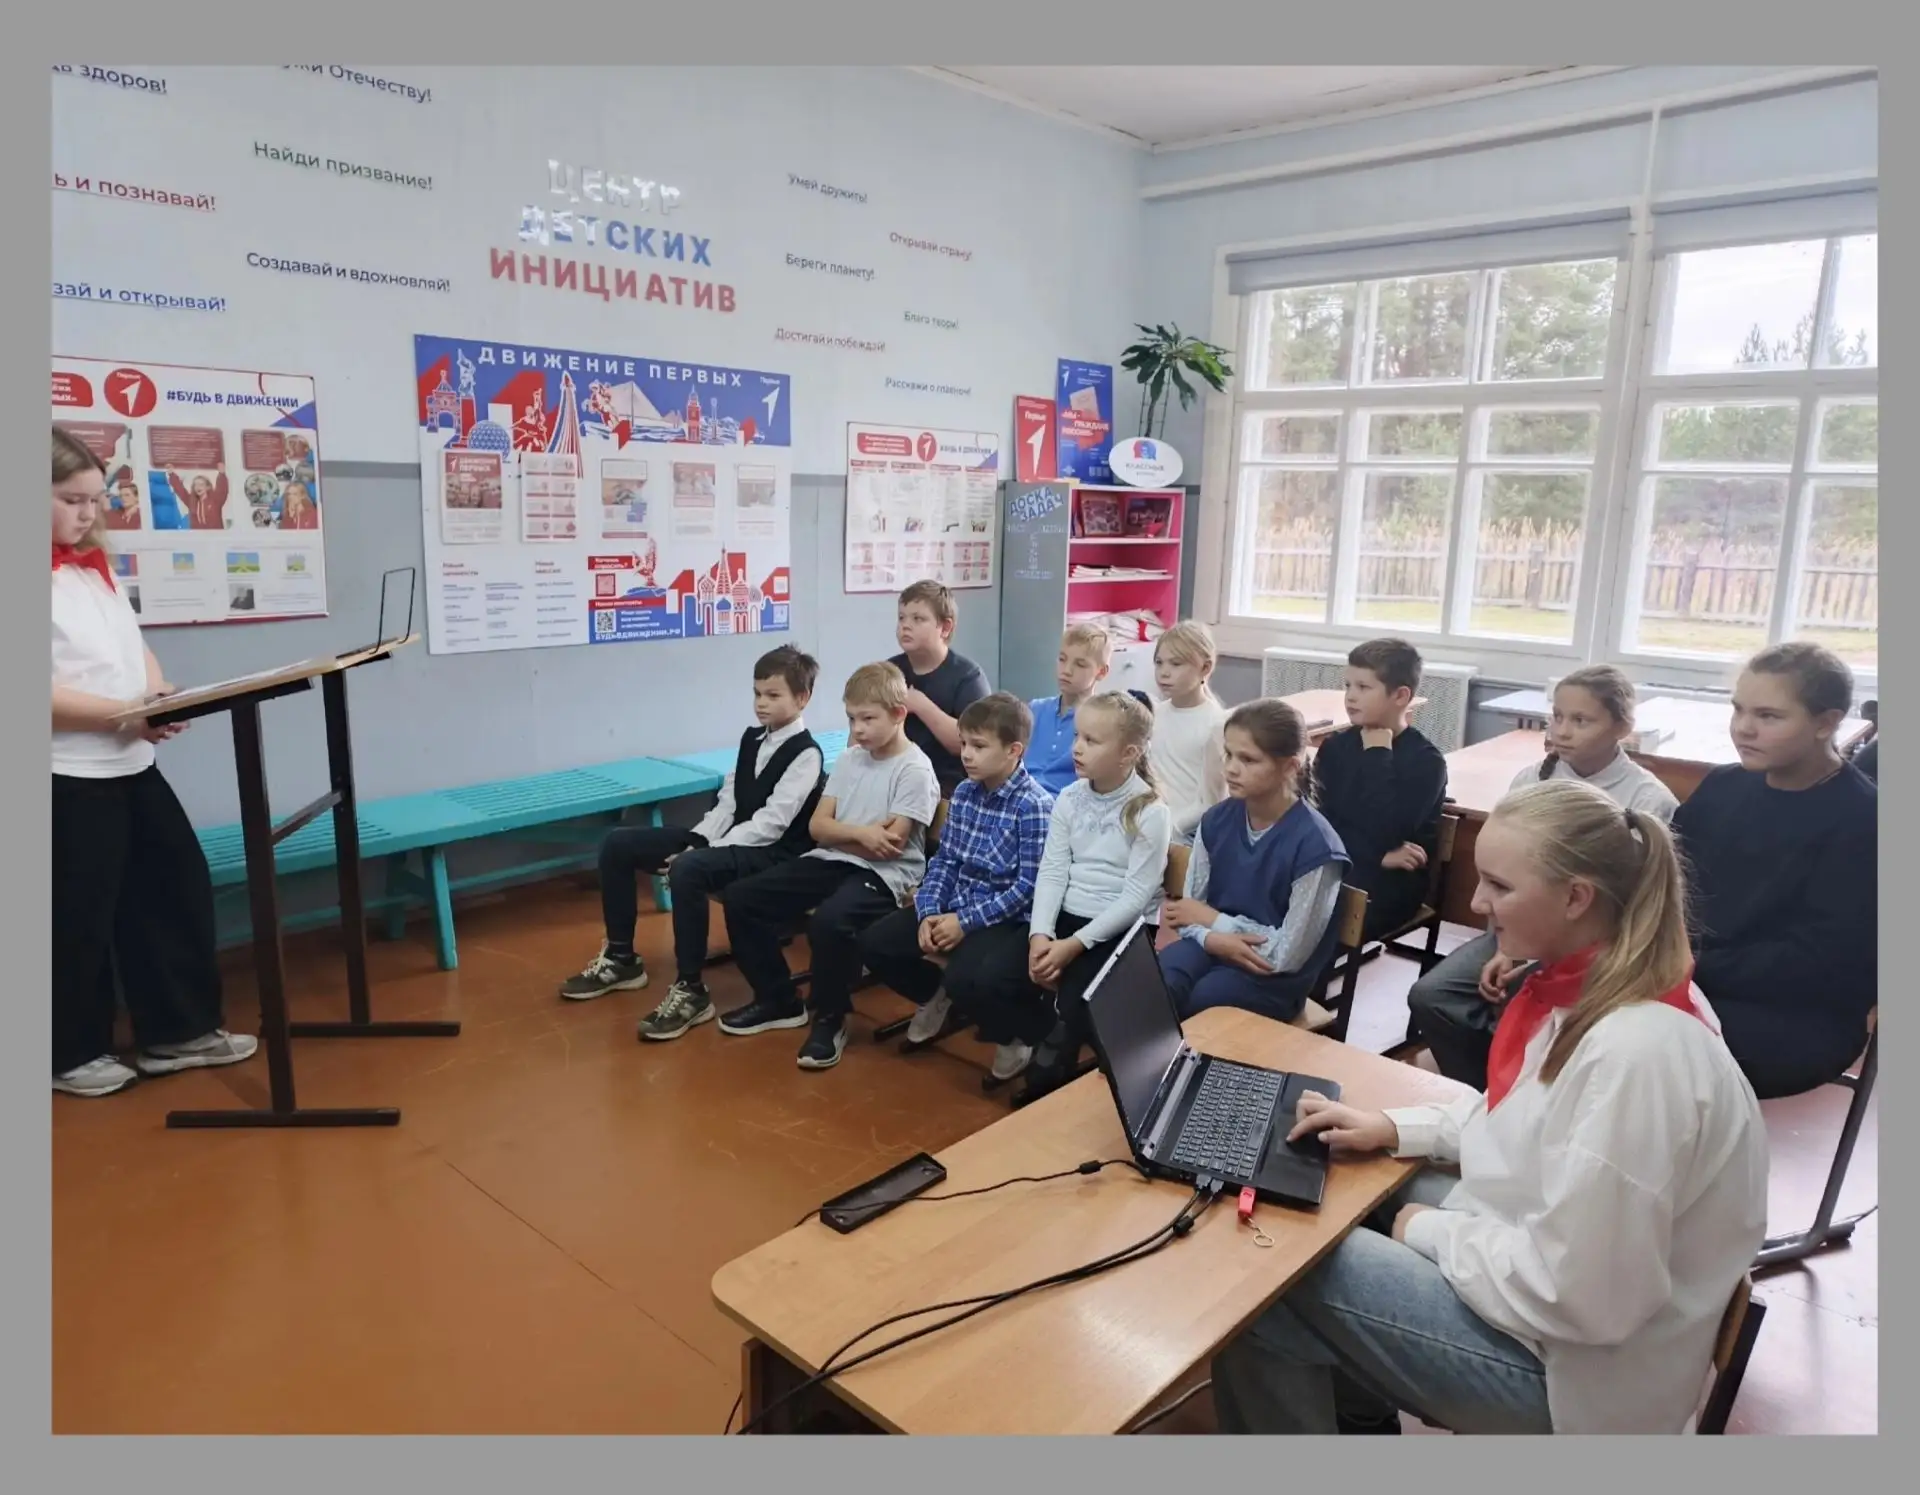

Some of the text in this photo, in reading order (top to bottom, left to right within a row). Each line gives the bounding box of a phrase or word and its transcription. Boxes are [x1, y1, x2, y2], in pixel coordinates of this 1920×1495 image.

[79, 64, 168, 94] здоров!
[329, 64, 432, 103] Отечеству!
[253, 141, 433, 190] Найди призвание!
[75, 176, 91, 191] и
[98, 180, 216, 211] познавай!
[518, 204, 712, 267] ДЕТСКИХ
[246, 252, 451, 293] Создавай и вдохновляй!
[490, 247, 737, 313] ИНИЦИАТИВ
[785, 252, 827, 272] Береги
[99, 288, 113, 300] и
[118, 289, 227, 313] открывай!
[478, 346, 742, 387] ДВИЖЕНИЕ ПЕРВЫХ
[166, 390, 299, 408] #БУДЬ В ДВИЖЕНИИ
